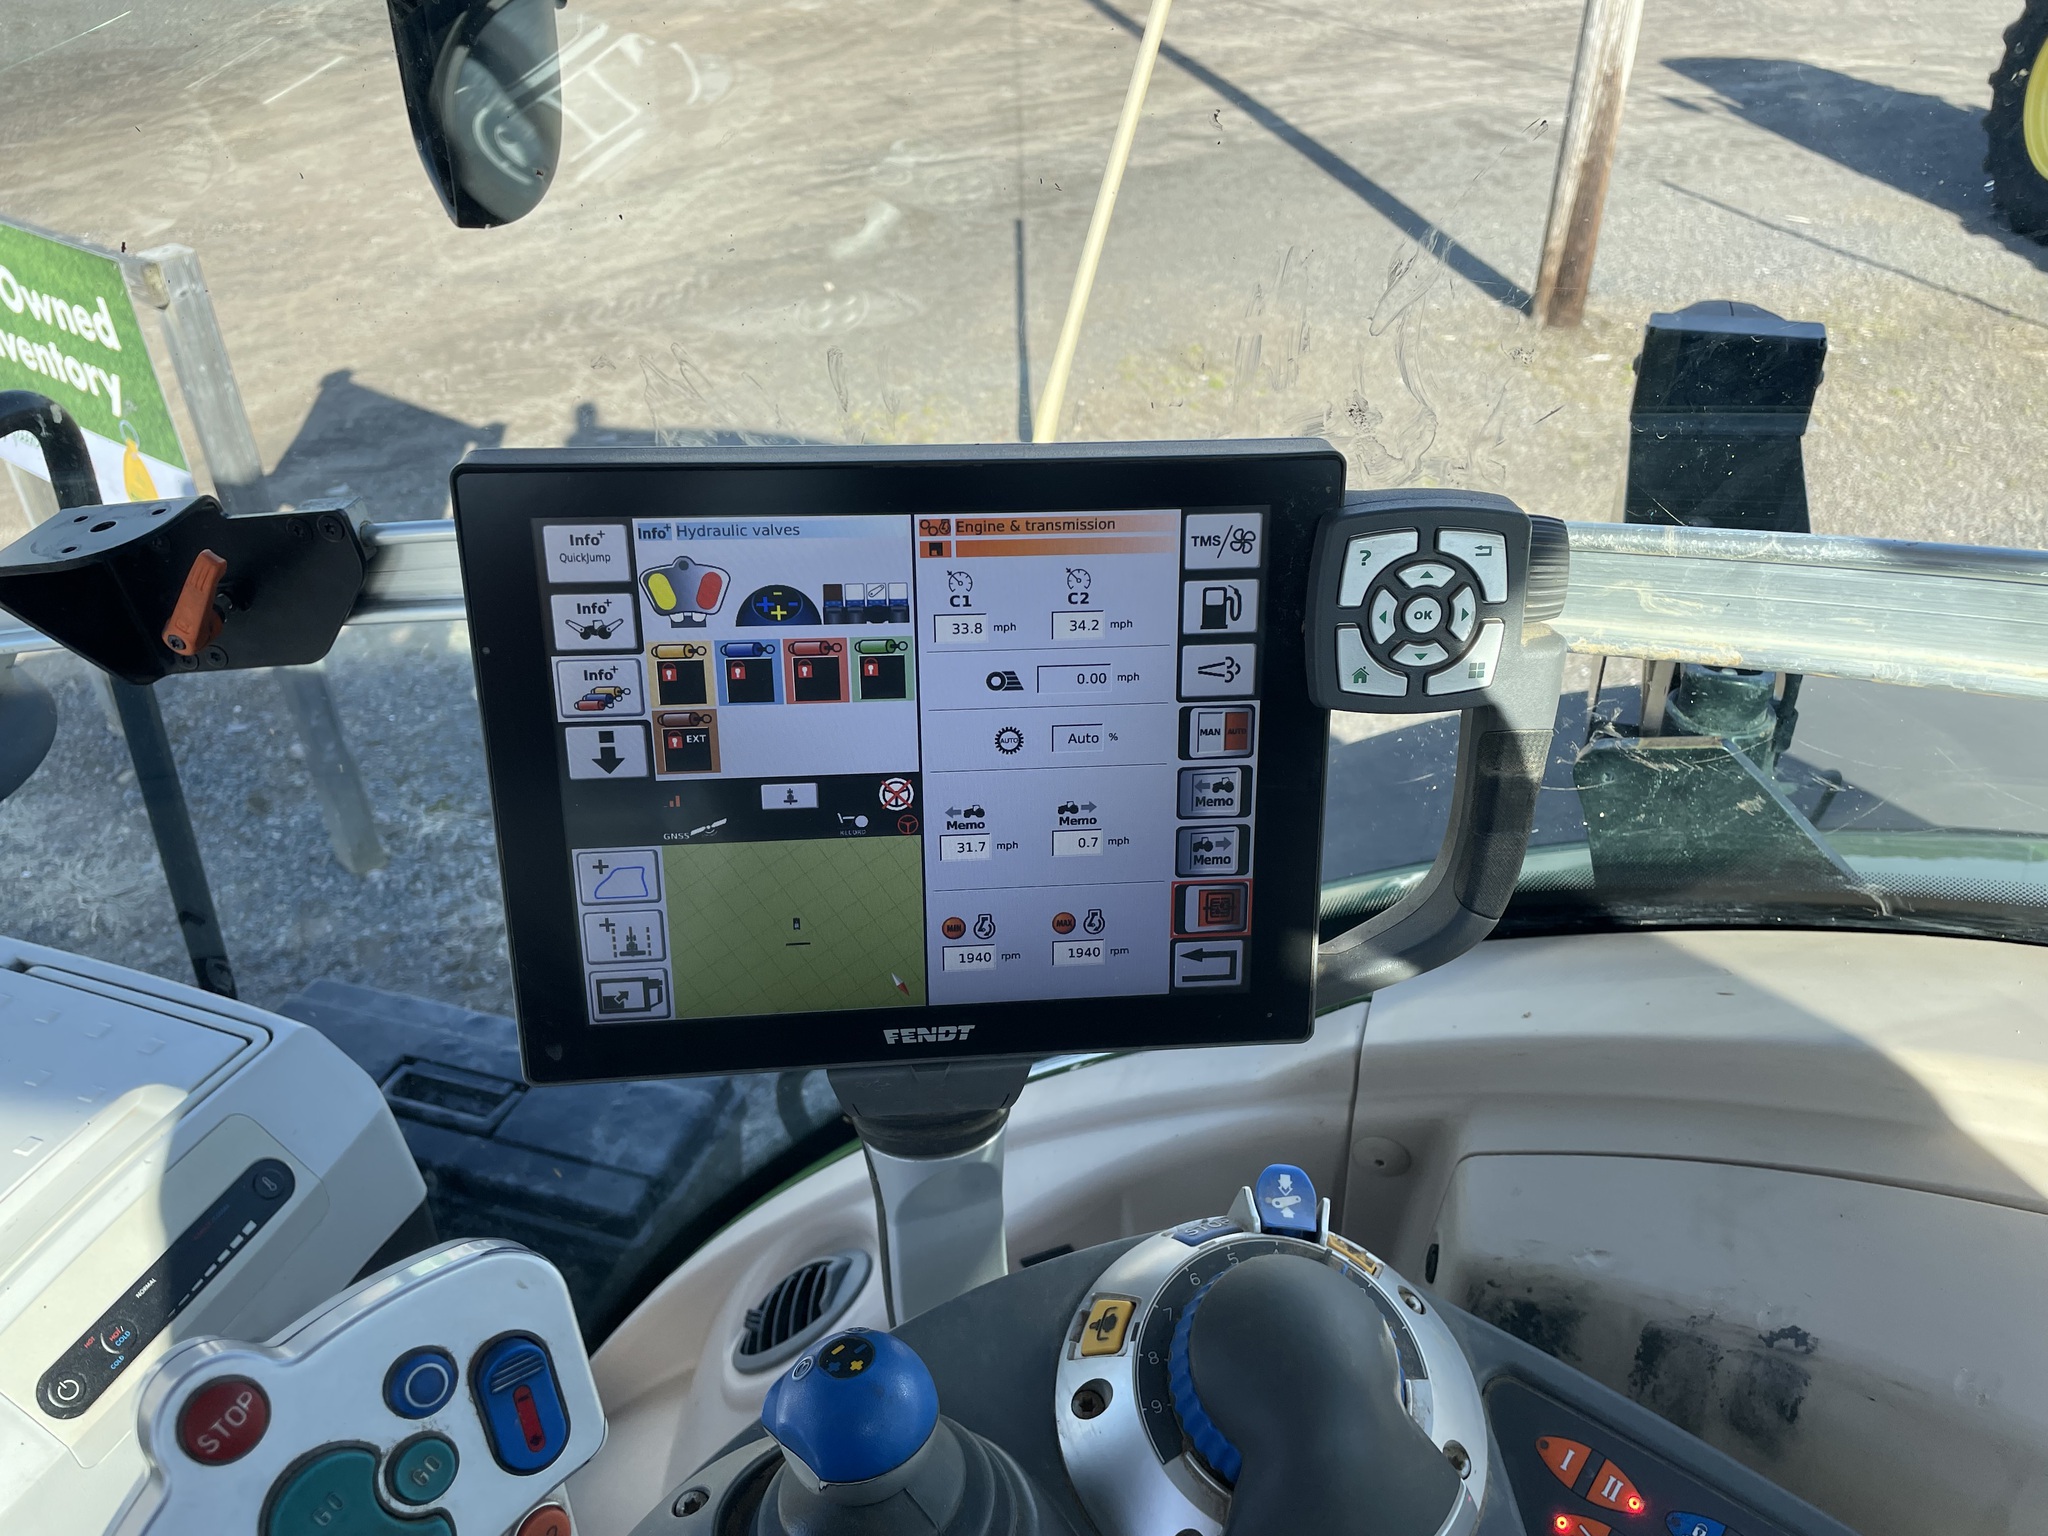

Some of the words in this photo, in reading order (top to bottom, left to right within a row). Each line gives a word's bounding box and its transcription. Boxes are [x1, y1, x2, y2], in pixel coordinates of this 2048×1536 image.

[0, 264, 122, 351] Owned
[0, 328, 122, 418] ventory
[676, 524, 748, 540] Hydraulic
[752, 523, 800, 537] valves
[956, 521, 1005, 535] Engine
[1009, 520, 1020, 532] &
[1025, 518, 1116, 532] transmission
[559, 553, 611, 564] QuickJump
[949, 595, 972, 608] C1
[1067, 592, 1090, 605] C2
[1413, 610, 1433, 621] OK
[952, 622, 983, 635] 33.8
[993, 622, 1017, 633] mph
[1069, 619, 1100, 632] 34.2
[1110, 619, 1133, 630] mph
[1077, 672, 1107, 685] 0.00
[1117, 672, 1140, 683] mph
[1068, 732, 1099, 744] Auto
[1108, 732, 1118, 741] %
[1199, 728, 1221, 736] MAN
[686, 734, 707, 744] EXT
[1000, 737, 1019, 745] AUTO
[1195, 796, 1234, 807] Memo
[946, 820, 986, 831] Memo
[1059, 816, 1097, 827] Memo
[663, 832, 690, 841] GNSS
[1078, 837, 1098, 848] 0.7
[1108, 837, 1130, 847] mph
[957, 841, 986, 853] 31.7
[996, 841, 1019, 851] mph
[1193, 855, 1231, 866] Memo
[1056, 918, 1073, 927] MAX
[958, 952, 992, 964] 1940
[1001, 952, 1021, 961] rpm
[1068, 947, 1101, 958] 1940
[1110, 946, 1130, 956] rpm
[882, 1024, 976, 1045] FENDT
[1189, 1271, 1201, 1286] 6
[135, 1277, 157, 1299] NORMAL
[1163, 1306, 1174, 1321] 7
[83, 1335, 96, 1349] HOT
[114, 1330, 131, 1347] COLD
[110, 1354, 125, 1371] COLD
[1147, 1350, 1159, 1365] 8
[1150, 1399, 1163, 1414] 9
[197, 1390, 255, 1454] STOP
[411, 1454, 443, 1487] GO
[312, 1490, 345, 1527] GO
